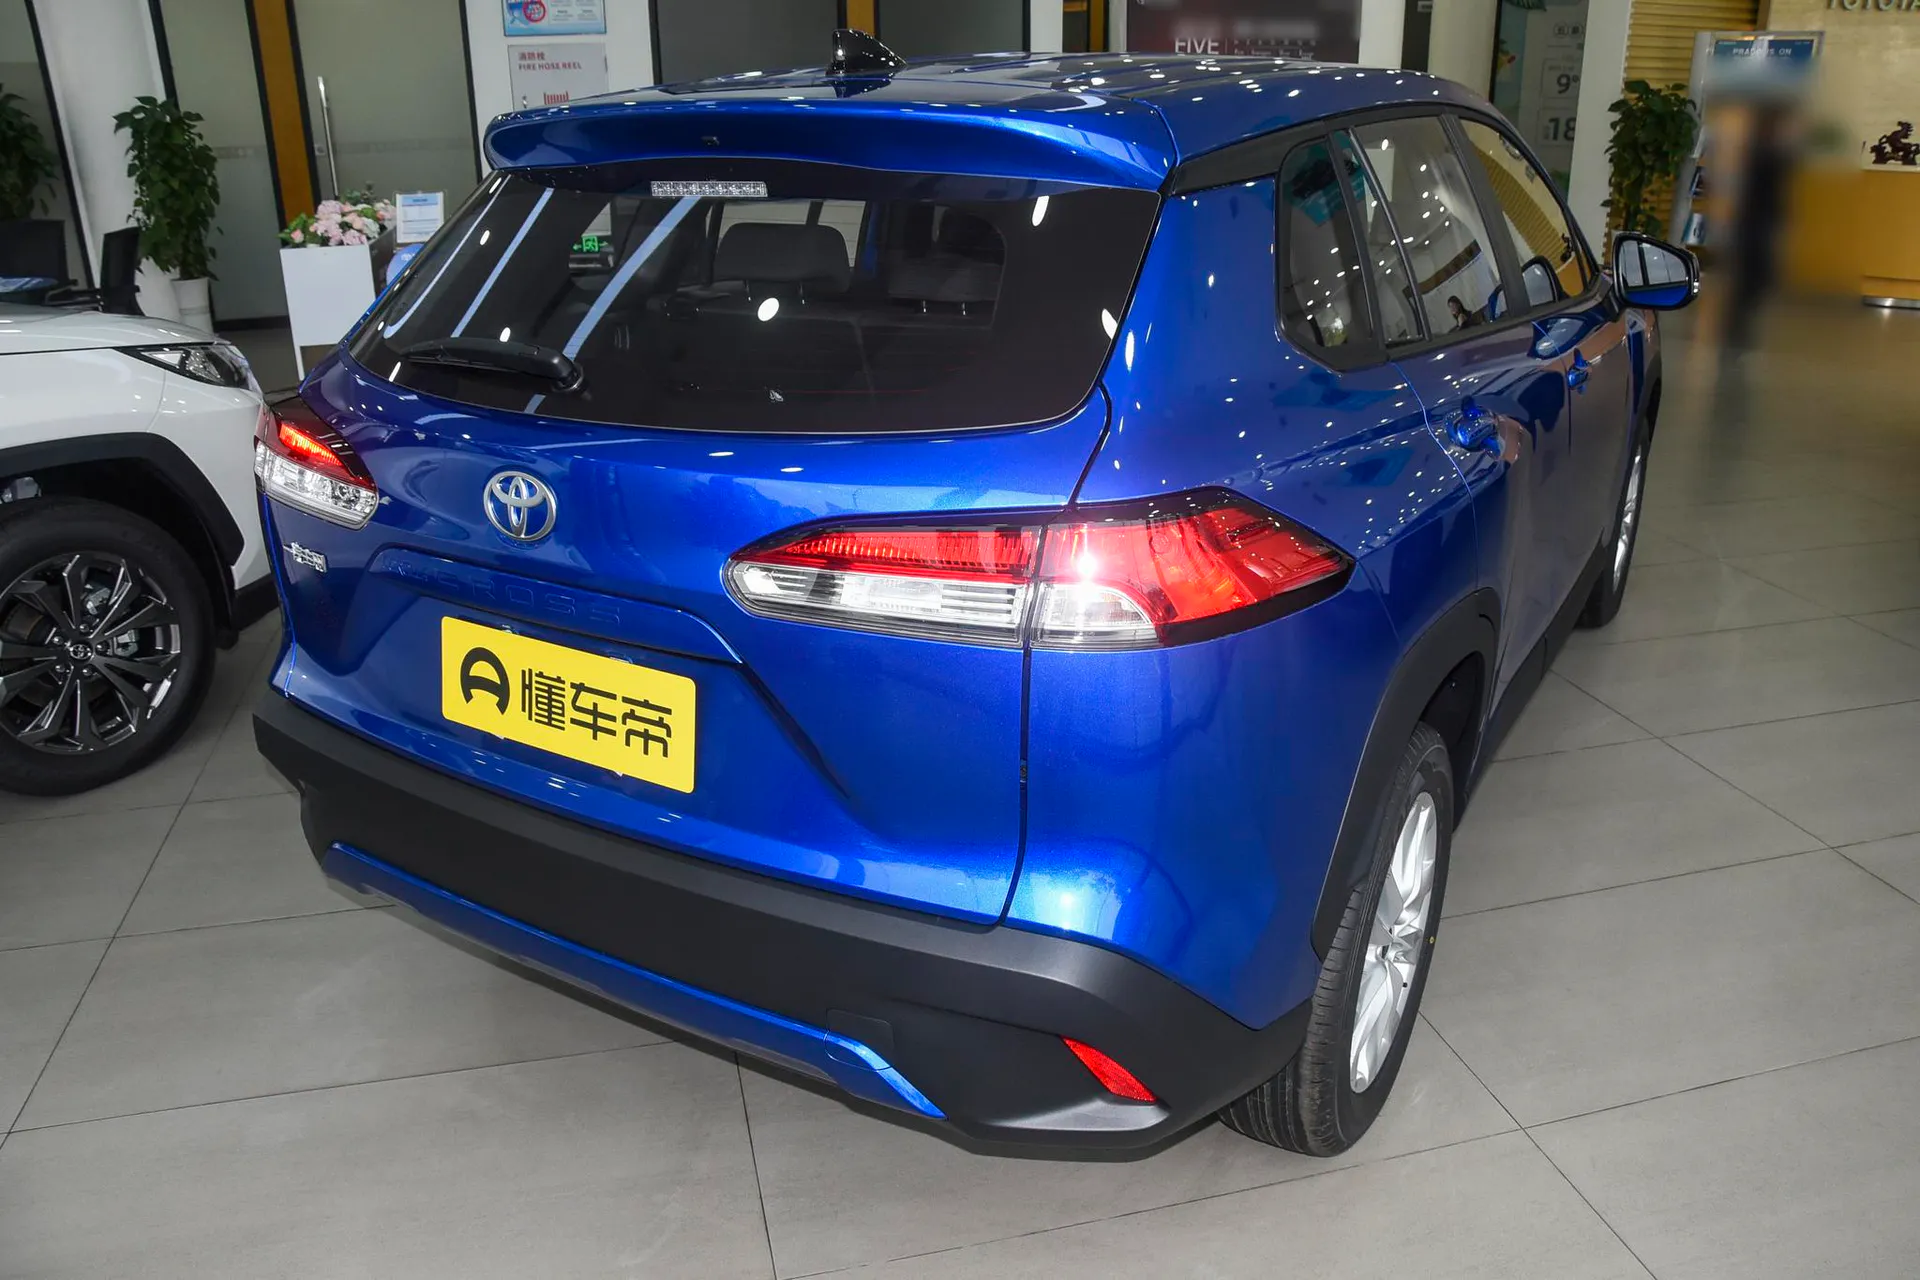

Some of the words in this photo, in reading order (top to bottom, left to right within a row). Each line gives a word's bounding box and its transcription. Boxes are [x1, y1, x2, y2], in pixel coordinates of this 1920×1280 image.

[518, 62, 537, 71] FIRE
[521, 667, 673, 759] 懂车帝
